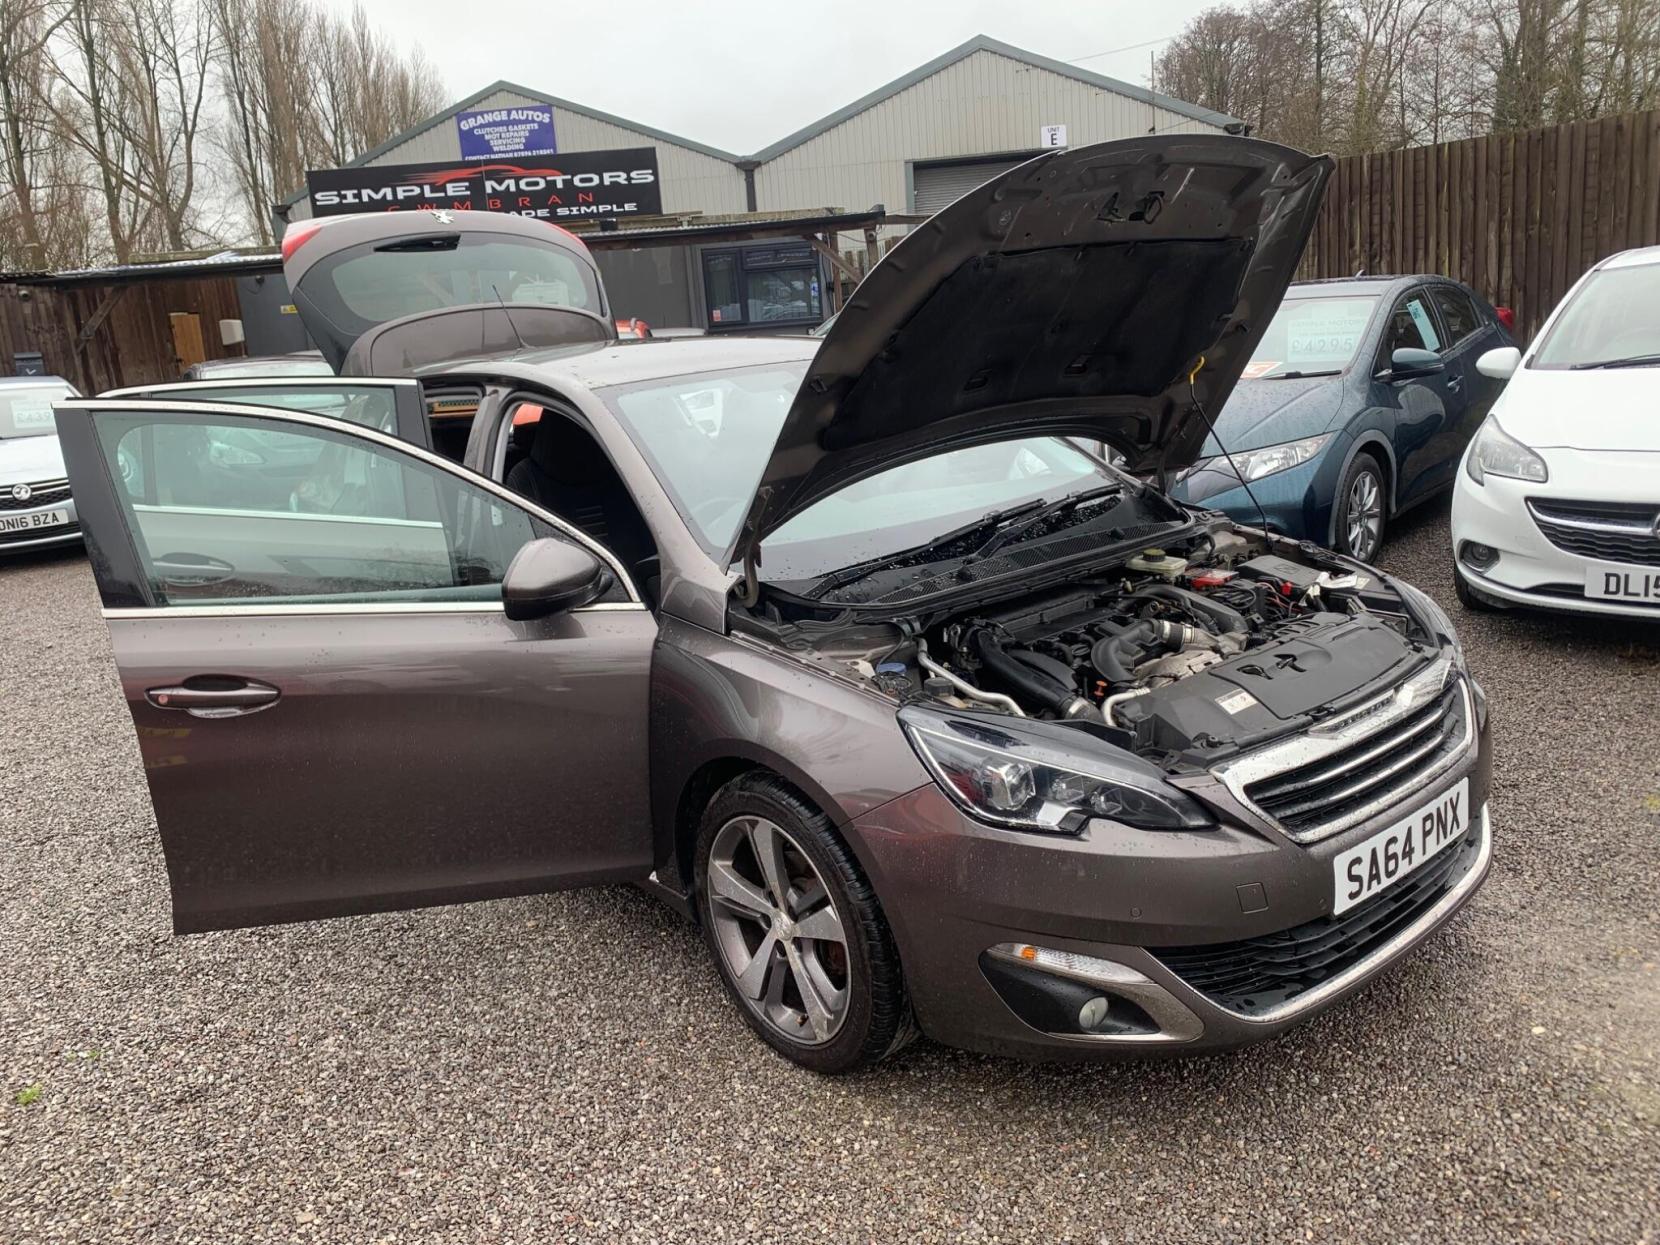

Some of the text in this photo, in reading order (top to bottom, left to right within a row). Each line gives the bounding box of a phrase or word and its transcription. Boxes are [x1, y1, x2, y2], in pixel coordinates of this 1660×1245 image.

[460, 109, 551, 130] GRANGE AUTOS
[473, 122, 539, 135] CLUTCHES GASKETS
[501, 130, 529, 139] REPAIRS
[490, 137, 526, 147] SERVICING
[1050, 133, 1058, 146] E
[314, 169, 655, 206] SIMPLE MOTORS
[508, 202, 638, 218] ADE SIMPLE
[32, 512, 60, 526] BZA
[1347, 791, 1460, 901] SA64 PNX
